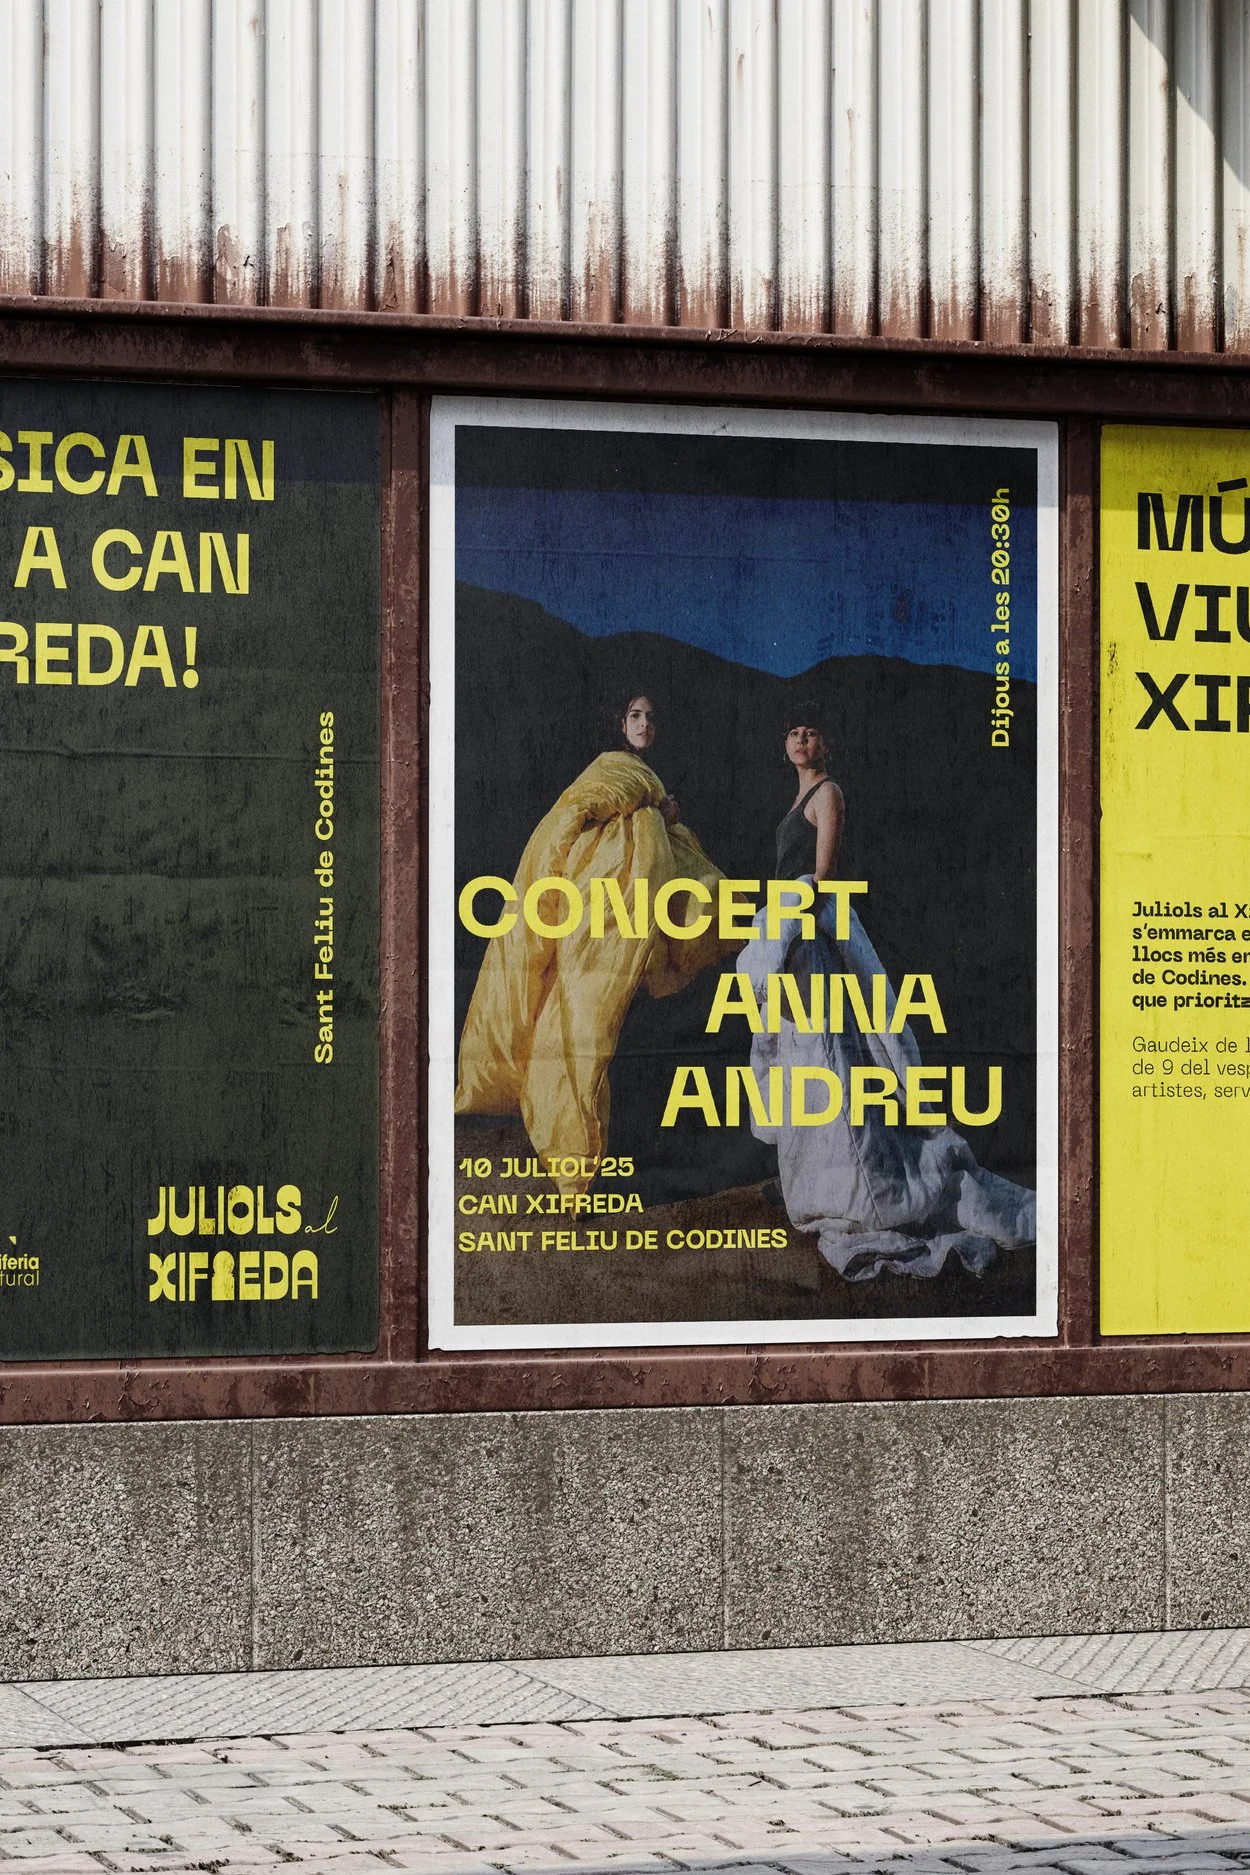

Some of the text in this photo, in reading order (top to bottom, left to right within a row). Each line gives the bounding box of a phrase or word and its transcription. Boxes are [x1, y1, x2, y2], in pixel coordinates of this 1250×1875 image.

[183, 437, 274, 501] EN
[14, 526, 249, 594] A CAN
[991, 488, 1013, 747] Dijous a les 20:30h
[0, 622, 199, 689] REDA!
[314, 711, 334, 1064] Sant Feliu de Codines
[458, 875, 868, 941] CONCERT
[1132, 901, 1203, 918] Juliols
[1208, 902, 1228, 918] al
[1132, 945, 1183, 962] llocs
[1188, 947, 1227, 963] més
[1132, 969, 1155, 985] de
[1162, 969, 1247, 986] Codines.
[705, 973, 947, 1033] ANNA
[1132, 995, 1167, 1010] que
[1132, 1036, 1208, 1053] Gaudeix
[1216, 1037, 1237, 1053] de
[1132, 1059, 1154, 1075] de
[1162, 1059, 1173, 1075] 9
[1181, 1059, 1210, 1075] del
[661, 1066, 1002, 1127] ANDREU
[1132, 1083, 1207, 1100] artistes,
[459, 1157, 492, 1178] 10
[148, 1185, 339, 1235] JULIOLS al
[458, 1194, 644, 1214] CAN XIFREDA
[458, 1229, 788, 1252] SANT FELIU DE CODINES
